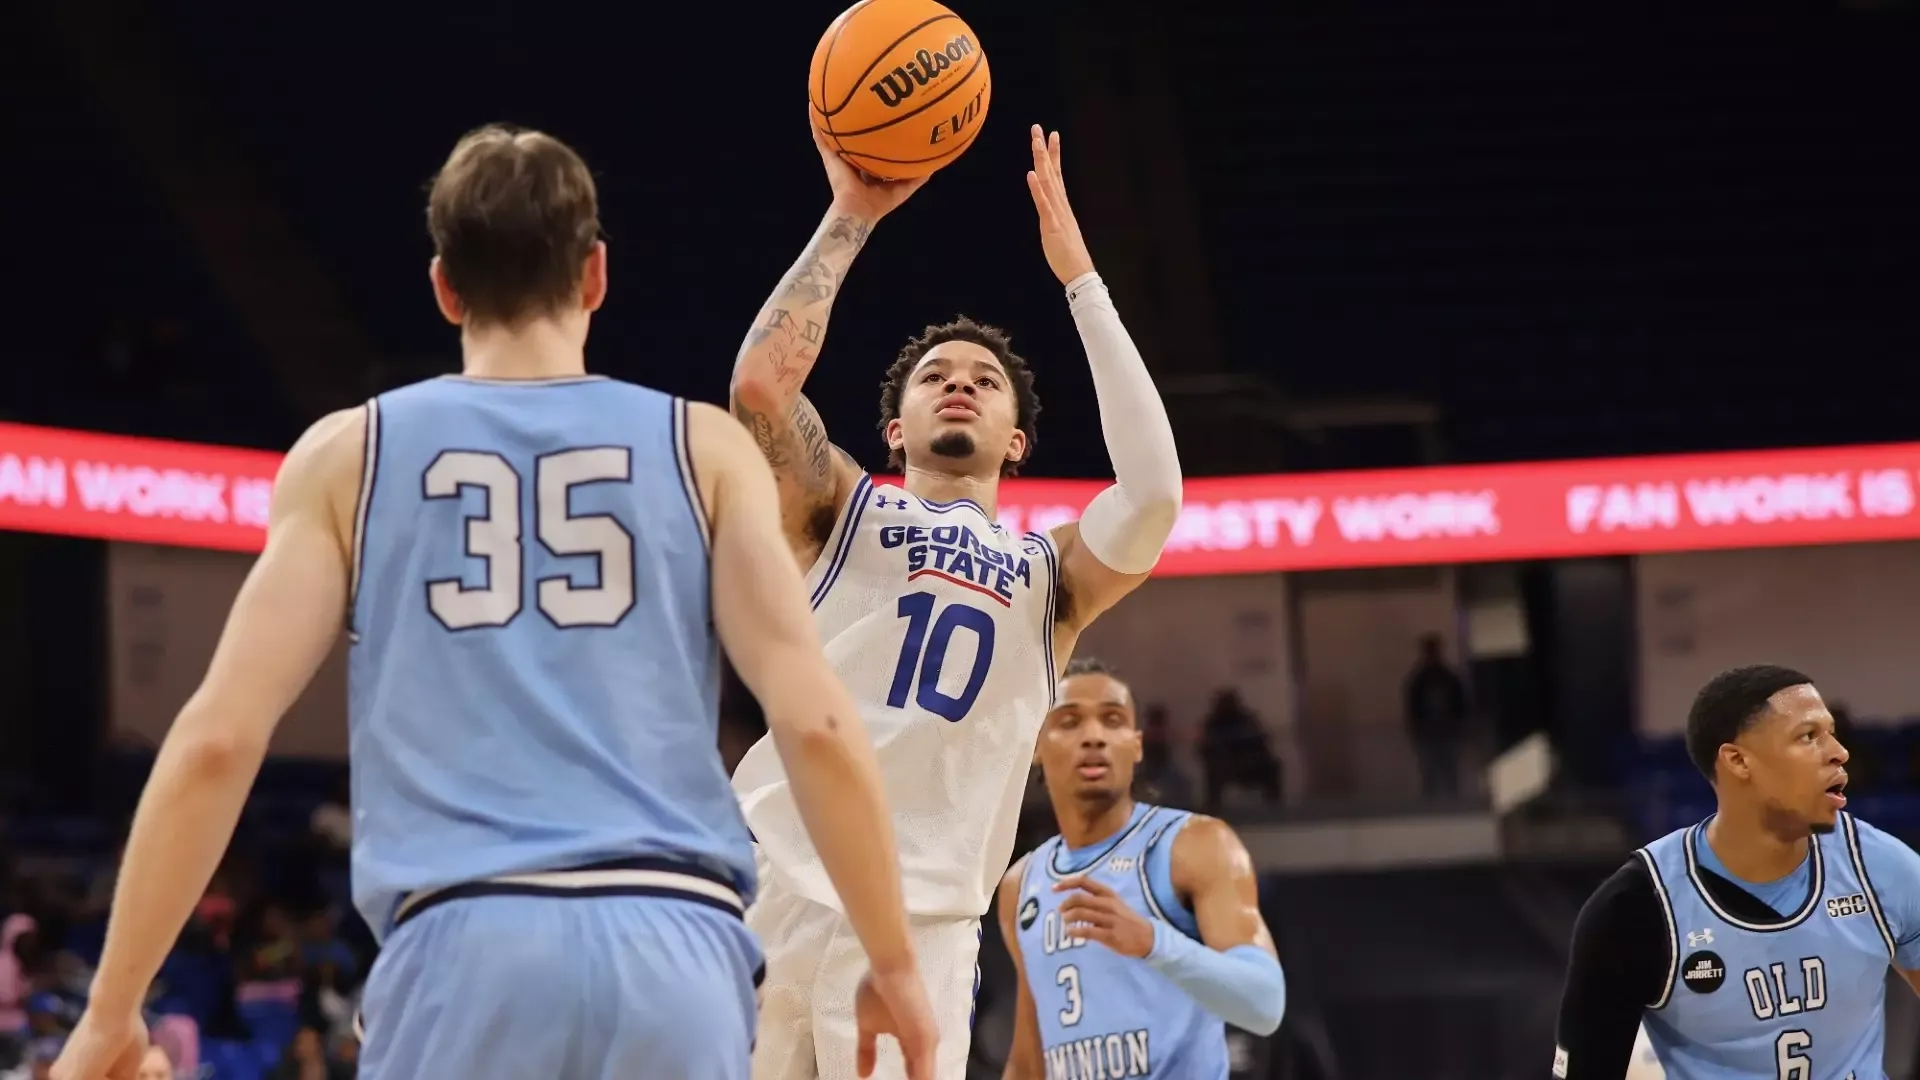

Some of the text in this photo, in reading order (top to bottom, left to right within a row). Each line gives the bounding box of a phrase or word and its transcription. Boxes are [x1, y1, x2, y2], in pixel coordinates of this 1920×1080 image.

[869, 34, 974, 107] Wilson
[789, 400, 818, 454] FEAR
[73, 460, 227, 522] WORK
[1332, 490, 1500, 542] WORK
[1566, 483, 1679, 533] FAN
[1684, 473, 1855, 526] WORK
[1859, 468, 1913, 517] IS
[421, 445, 637, 632] 35
[880, 525, 1031, 589] GEORGIA
[908, 545, 1016, 600] STATE
[886, 591, 996, 723] 10
[1826, 893, 1868, 918] SBC
[1055, 963, 1084, 1028] 3
[1684, 967, 1724, 980] JARRETT
[1695, 959, 1712, 970] JIM
[1743, 956, 1828, 1021] OLD
[1045, 1028, 1151, 1080] MINION
[1775, 1029, 1813, 1080] 6
